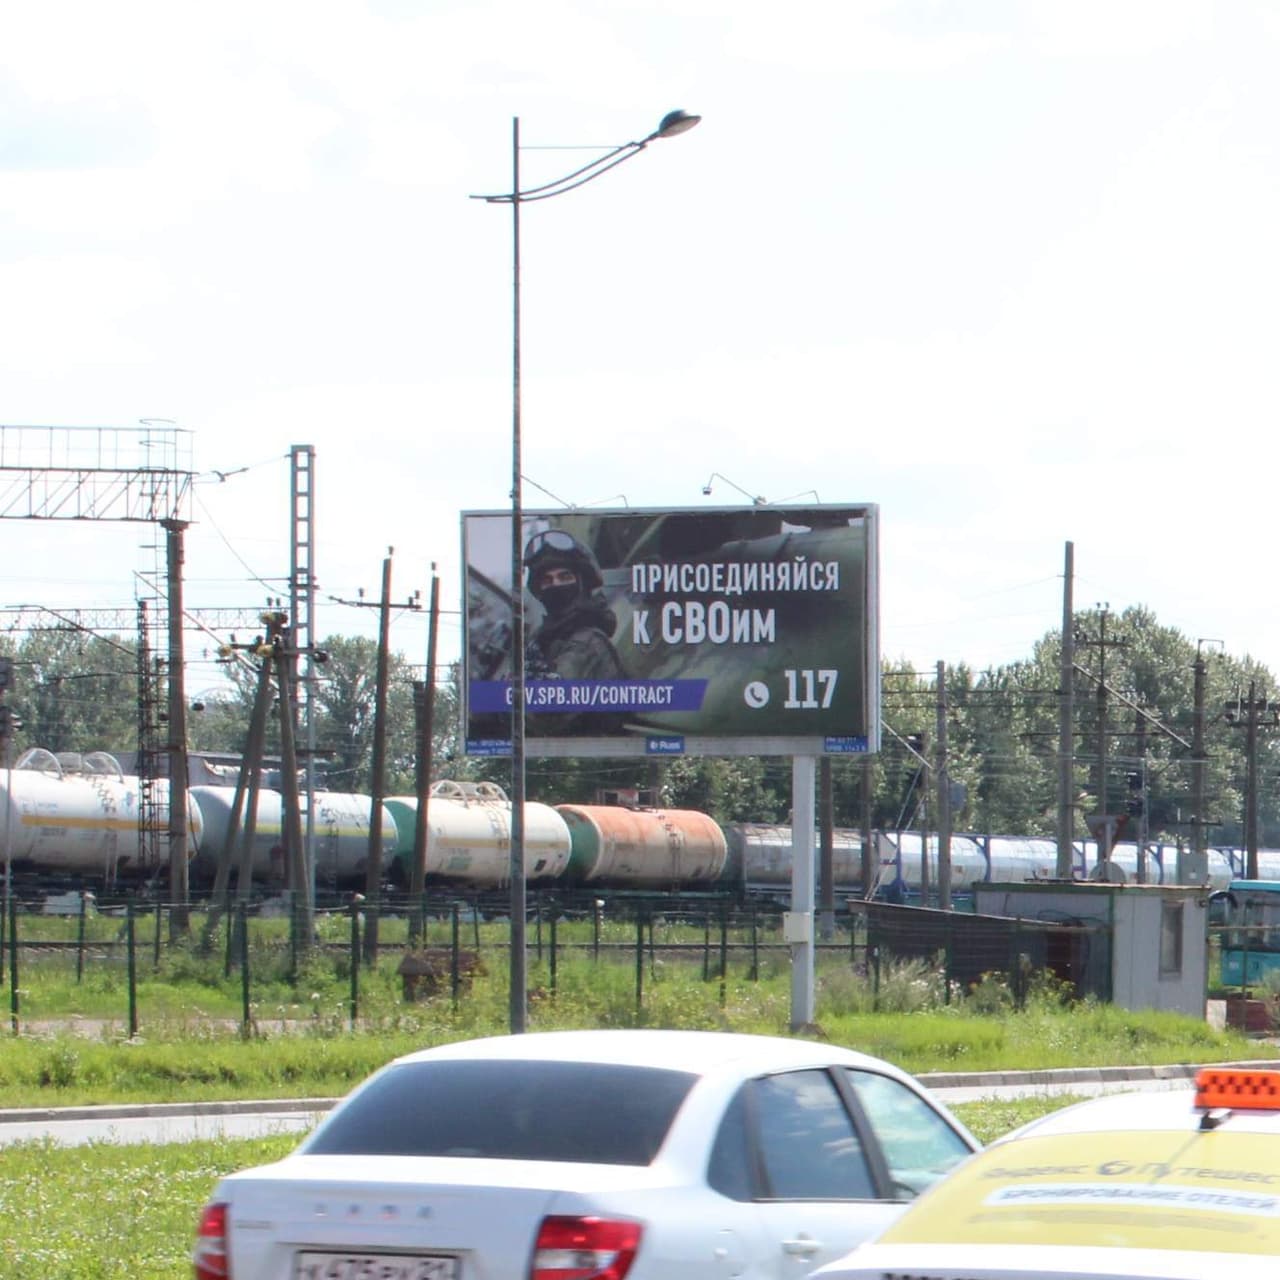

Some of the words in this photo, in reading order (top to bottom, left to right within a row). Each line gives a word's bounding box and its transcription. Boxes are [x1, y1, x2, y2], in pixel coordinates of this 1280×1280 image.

[632, 556, 839, 595] ПРИСОЕДИНЯЙСЯ
[505, 685, 673, 705] GV.SPB.RU/CONTRACT
[784, 669, 838, 709] 117
